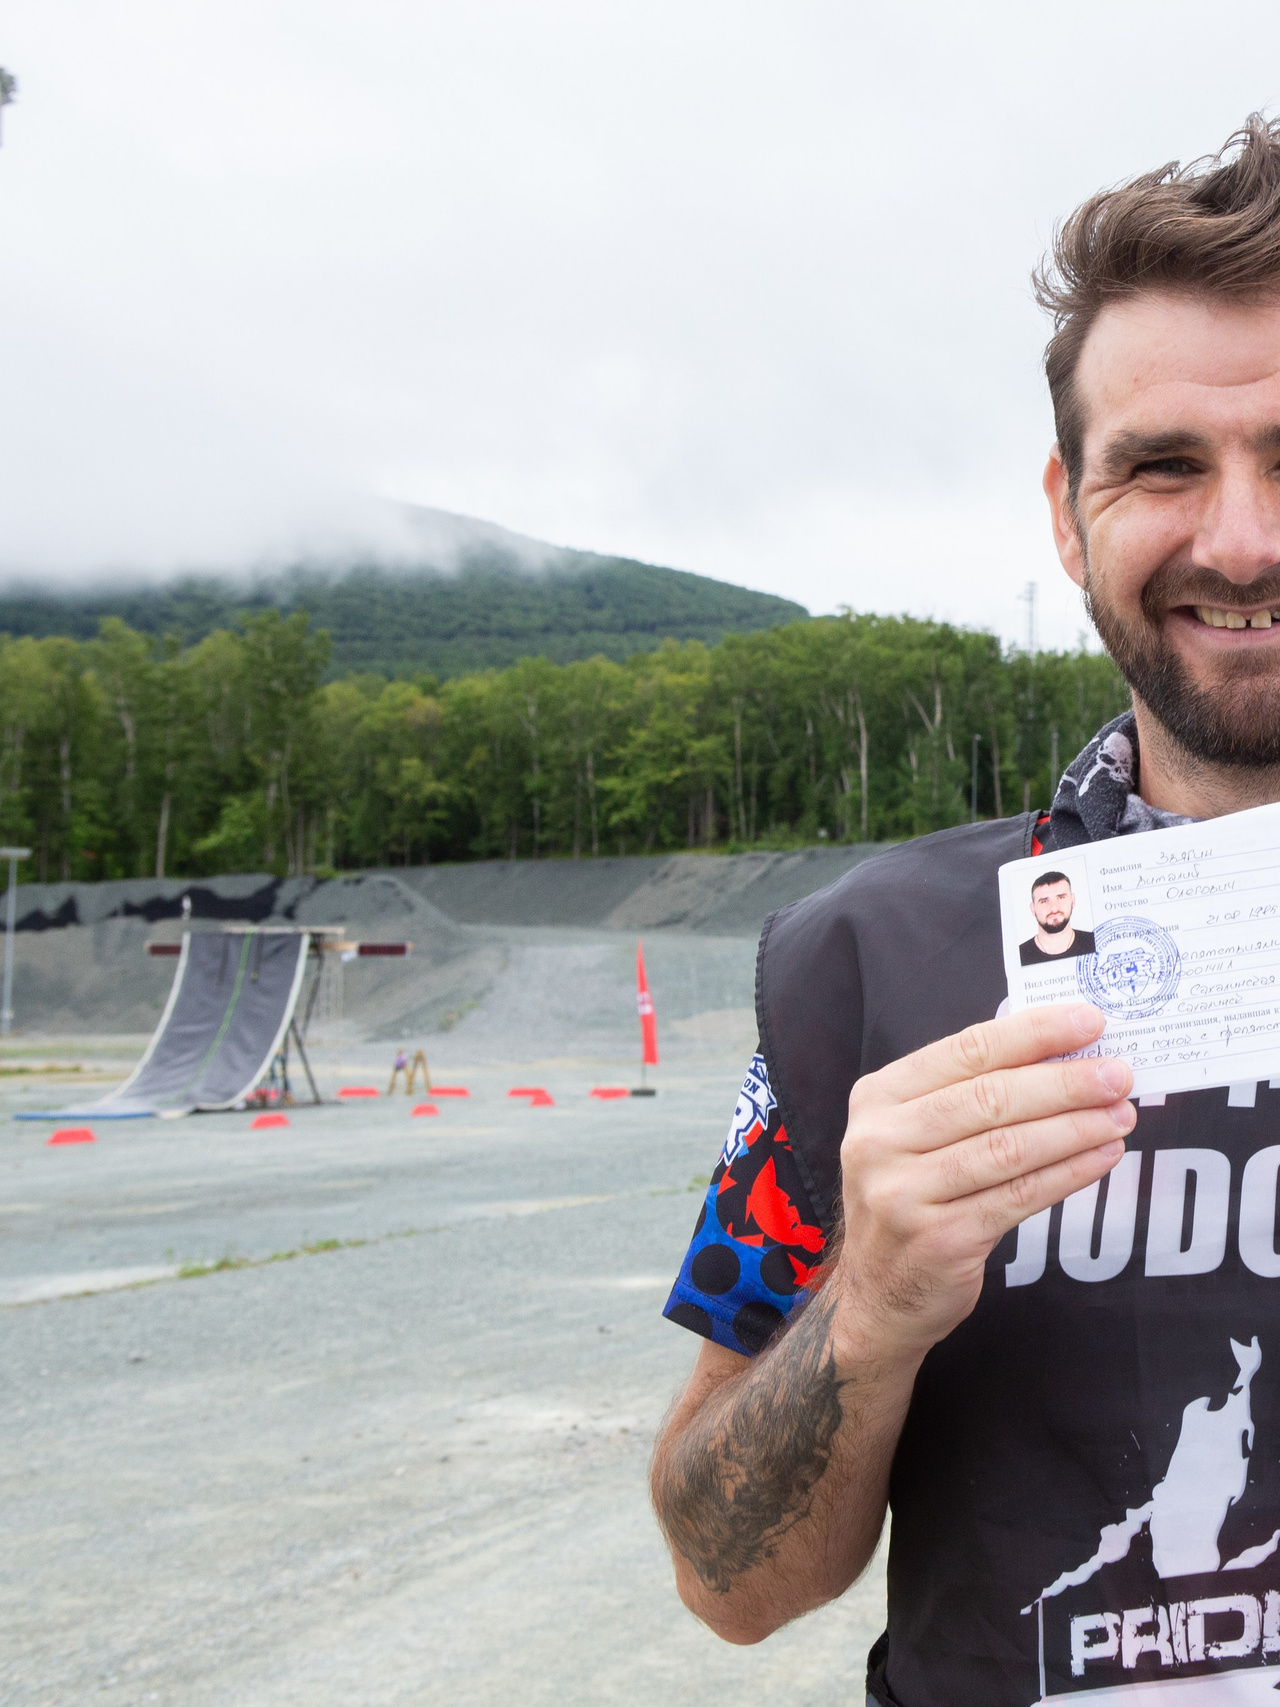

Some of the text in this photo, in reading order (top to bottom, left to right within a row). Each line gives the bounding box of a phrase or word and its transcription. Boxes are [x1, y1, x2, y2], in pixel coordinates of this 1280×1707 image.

[1100, 863, 1142, 876] Фамилия
[1102, 884, 1123, 894] Имя
[1104, 880, 1236, 911] Отчество Олегович
[1024, 980, 1041, 991] Вид
[1043, 975, 1076, 988] спорта
[1025, 988, 1076, 1005] Номер-код
[1158, 1016, 1221, 1034] организация,
[1223, 1008, 1271, 1023] выдавшая
